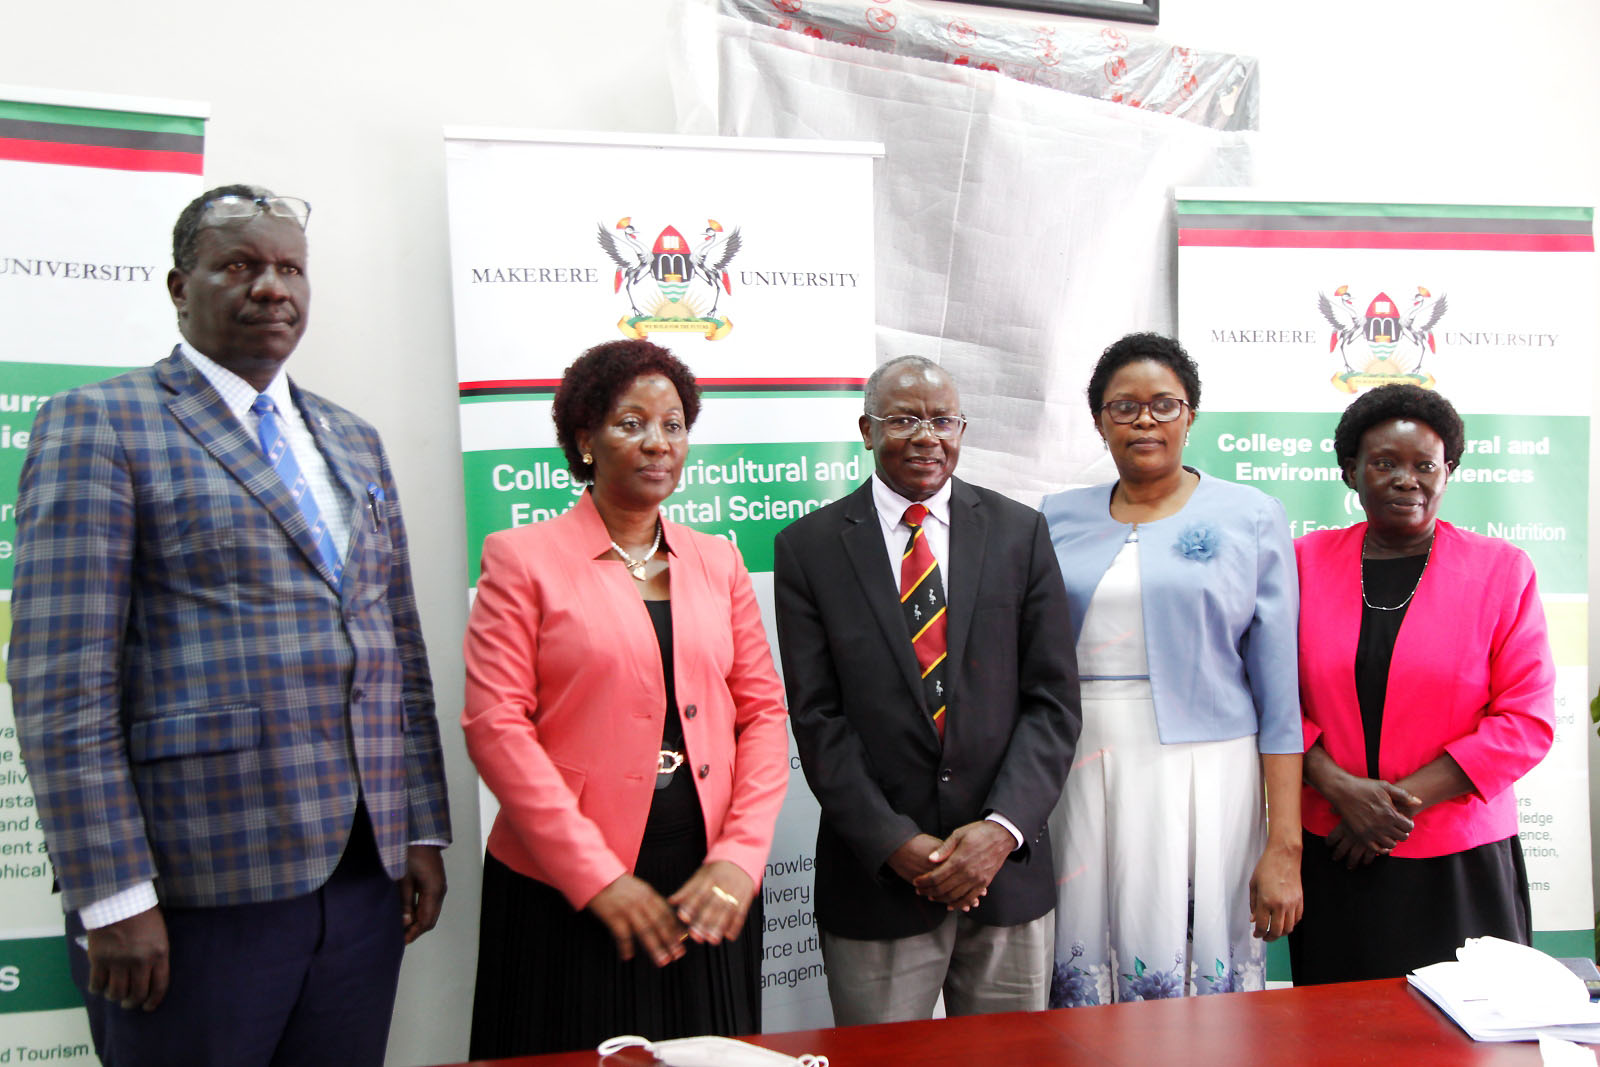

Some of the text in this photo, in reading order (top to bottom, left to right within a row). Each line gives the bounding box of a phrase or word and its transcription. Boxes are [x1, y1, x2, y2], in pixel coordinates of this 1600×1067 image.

[471, 267, 859, 287] MAKERERE UNIVERSITY
[1210, 329, 1560, 347] MAKERERE UNIVERSITY
[1217, 433, 1313, 457] College
[1507, 437, 1551, 455] and
[815, 455, 860, 481] and
[1487, 520, 1567, 541] Nutrition
[761, 963, 824, 989] anagem
[16, 1043, 89, 1063] Tourism
